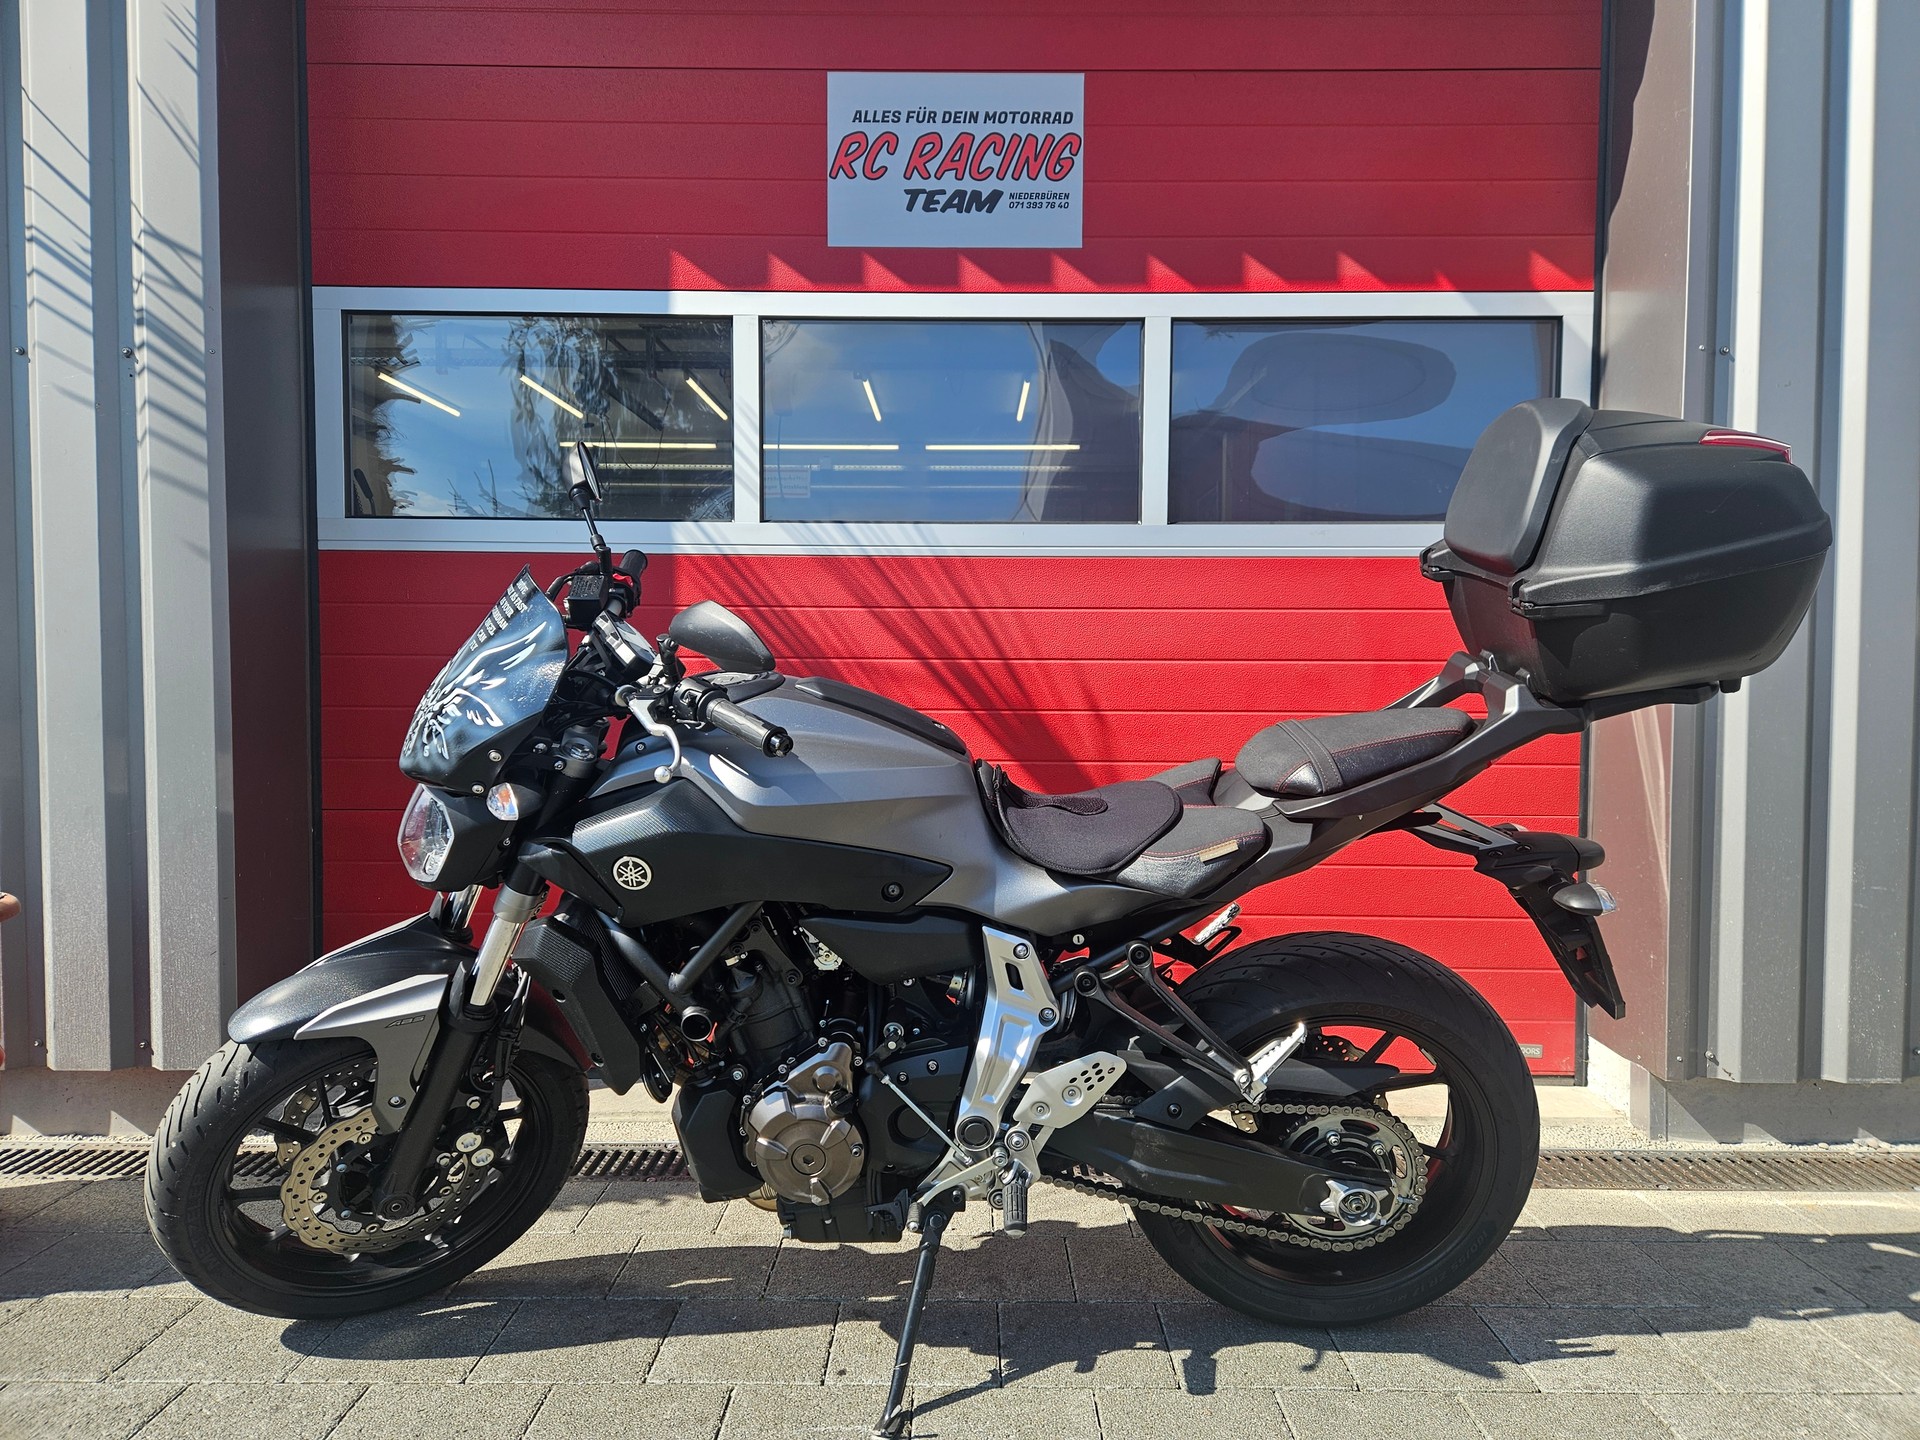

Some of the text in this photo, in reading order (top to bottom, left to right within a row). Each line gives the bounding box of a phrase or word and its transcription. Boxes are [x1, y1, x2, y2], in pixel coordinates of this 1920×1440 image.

[852, 106, 1074, 125] ALLES FÜR DEIN MOTORRAD
[829, 131, 1082, 182] RC RACING
[903, 188, 1004, 214] TEAM
[1008, 190, 1070, 200] NIEDERBÜREN
[1008, 201, 1070, 209] 071 393 76 40
[502, 602, 514, 618] YOUR
[514, 597, 528, 613] FAST
